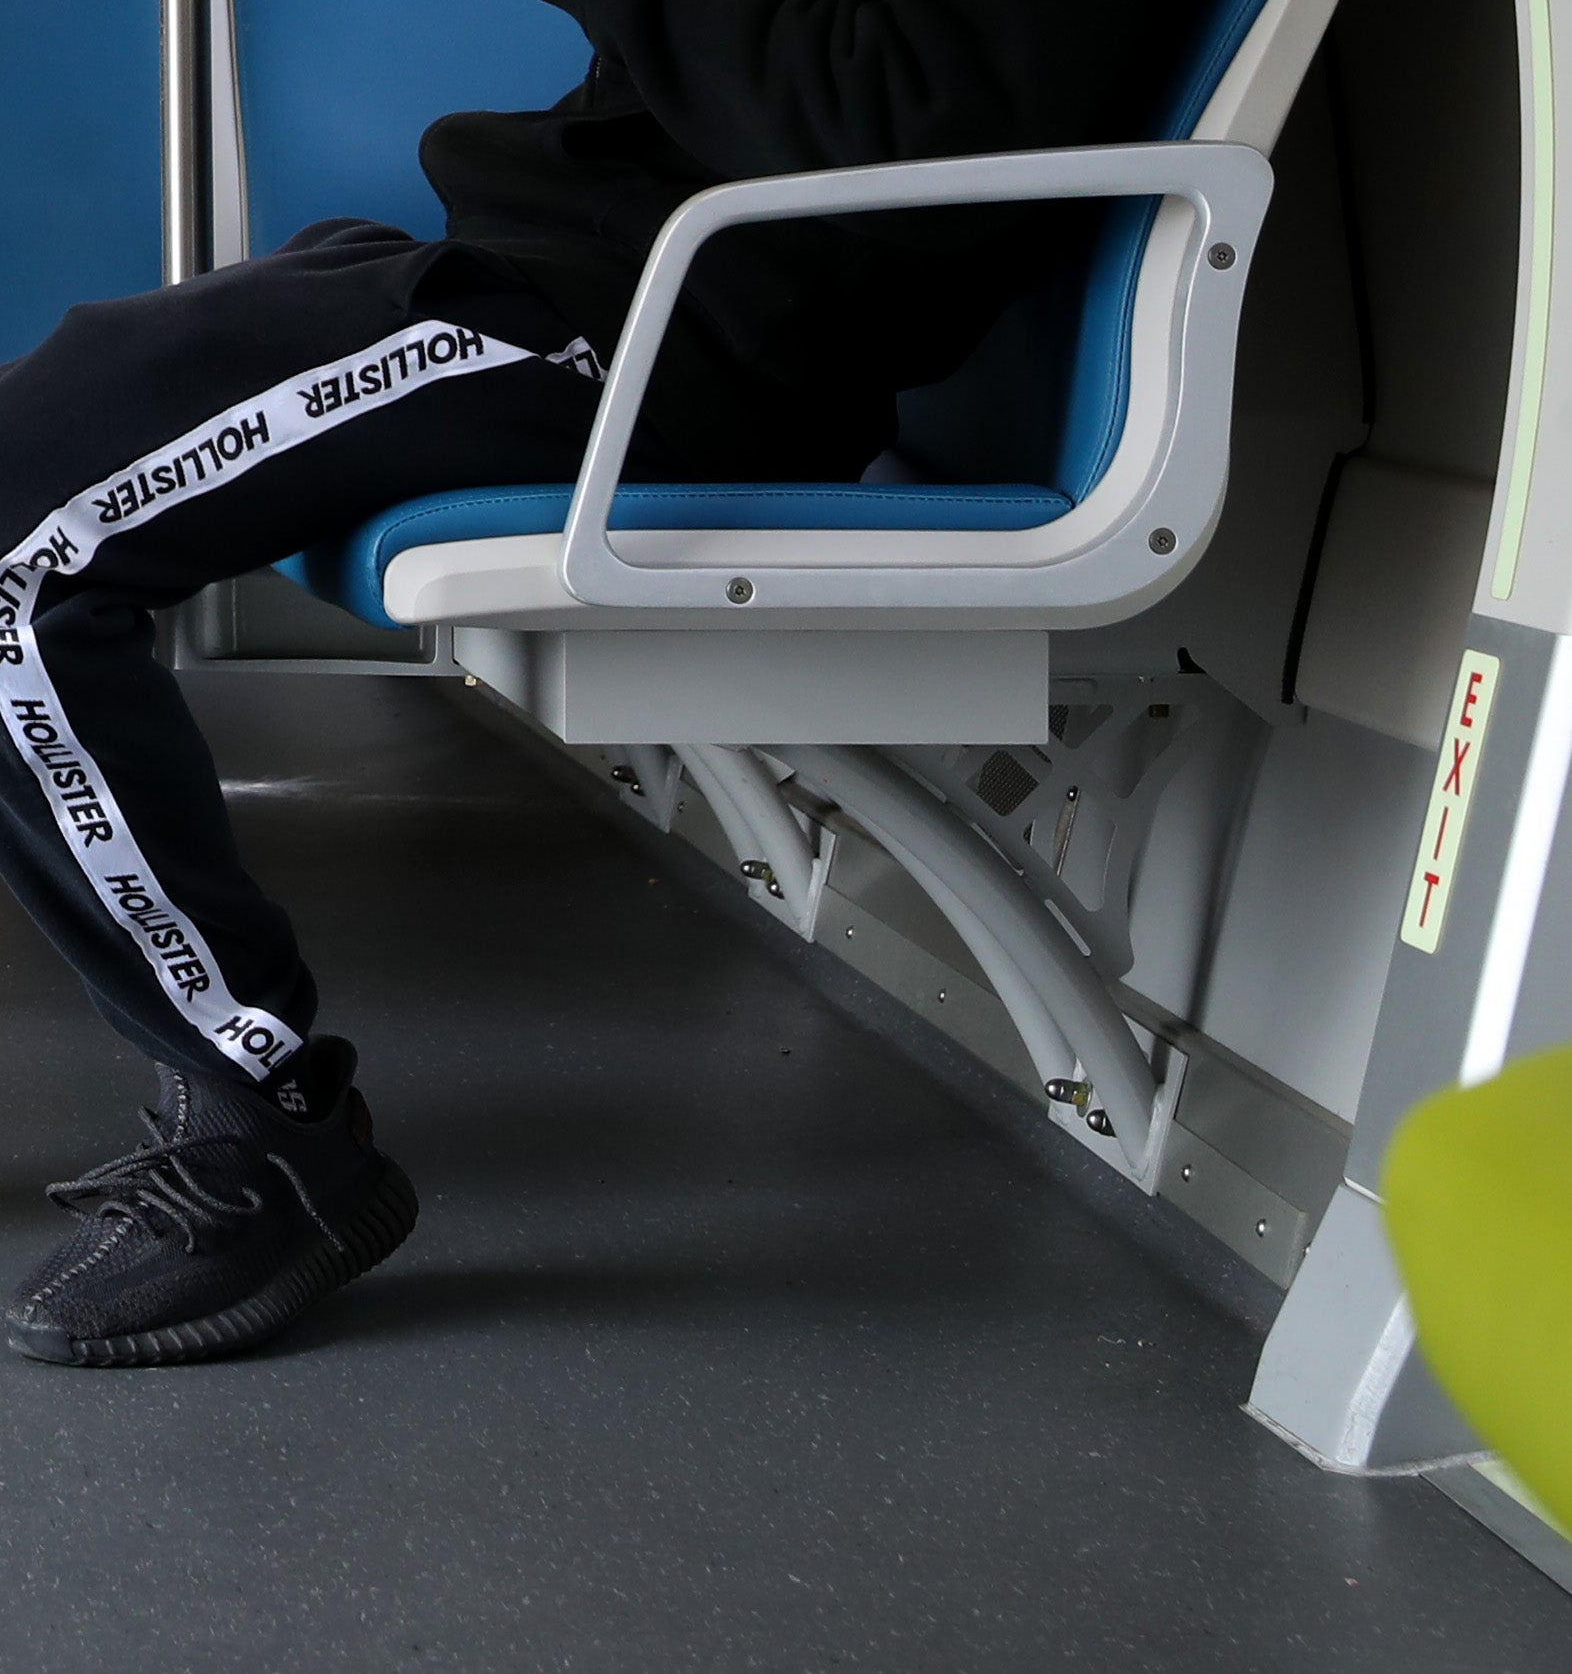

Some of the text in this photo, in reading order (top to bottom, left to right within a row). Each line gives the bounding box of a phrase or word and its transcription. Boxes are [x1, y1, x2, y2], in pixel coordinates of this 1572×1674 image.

[296, 328, 485, 419] HOLLISTER
[91, 410, 271, 524] HOLLISTER
[10, 698, 114, 849] HOLLISTER
[1418, 671, 1483, 928] EXIT
[103, 873, 211, 1004] HOLLISTER
